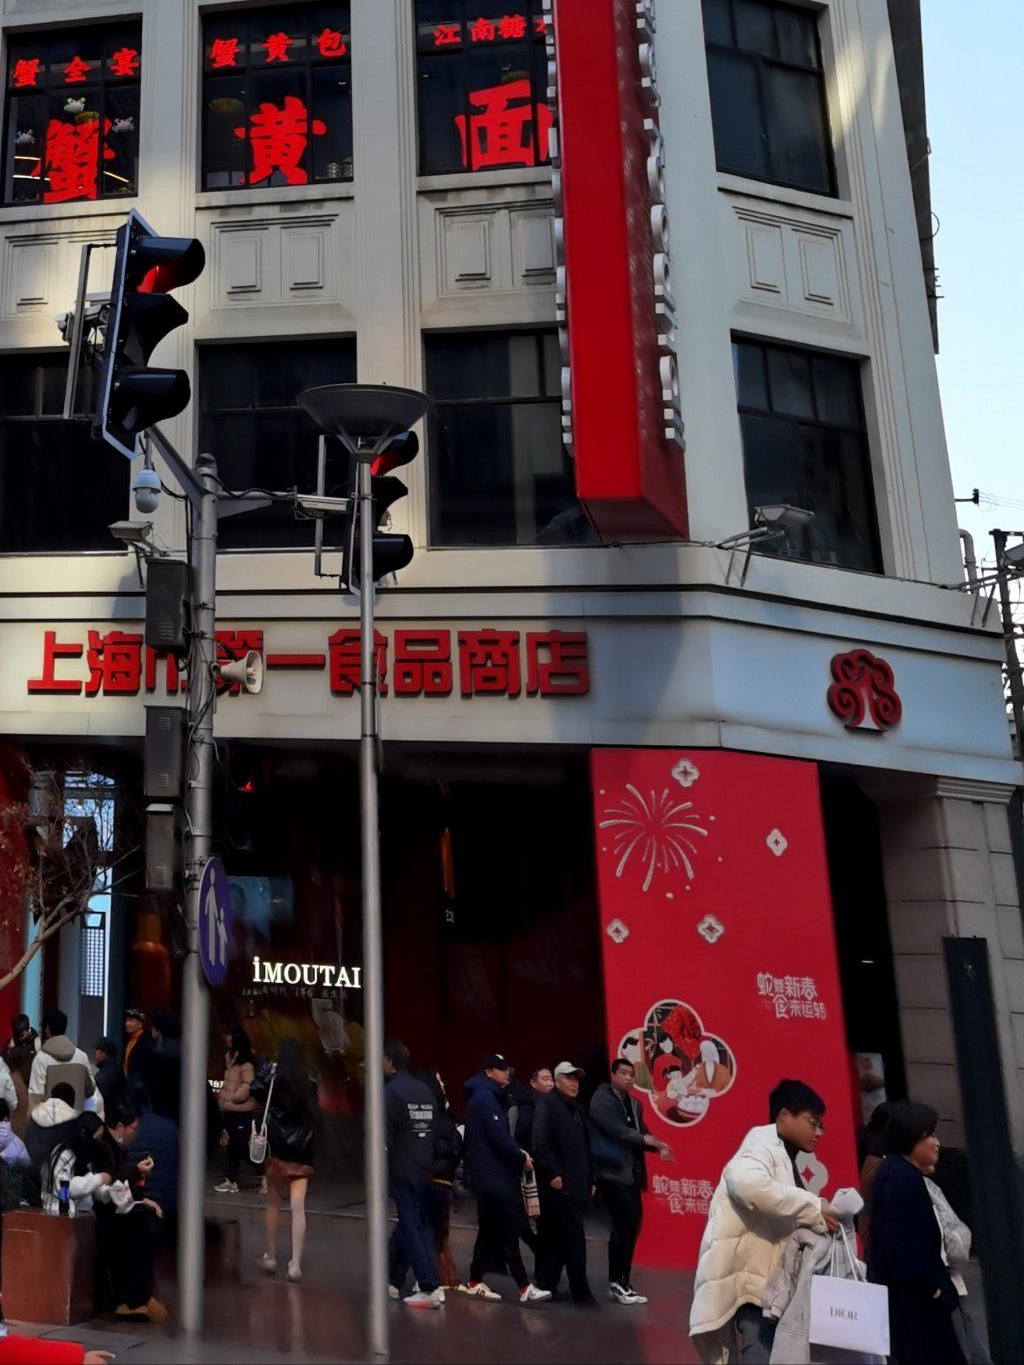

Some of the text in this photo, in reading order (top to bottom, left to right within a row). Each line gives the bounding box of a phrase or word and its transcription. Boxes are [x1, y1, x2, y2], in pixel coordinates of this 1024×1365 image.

[12, 47, 139, 88] 蟹全宴
[209, 28, 347, 69] 蟹黄包
[233, 95, 327, 185] 黄
[454, 79, 553, 171] 面
[829, 1306, 858, 1321] DIOR
